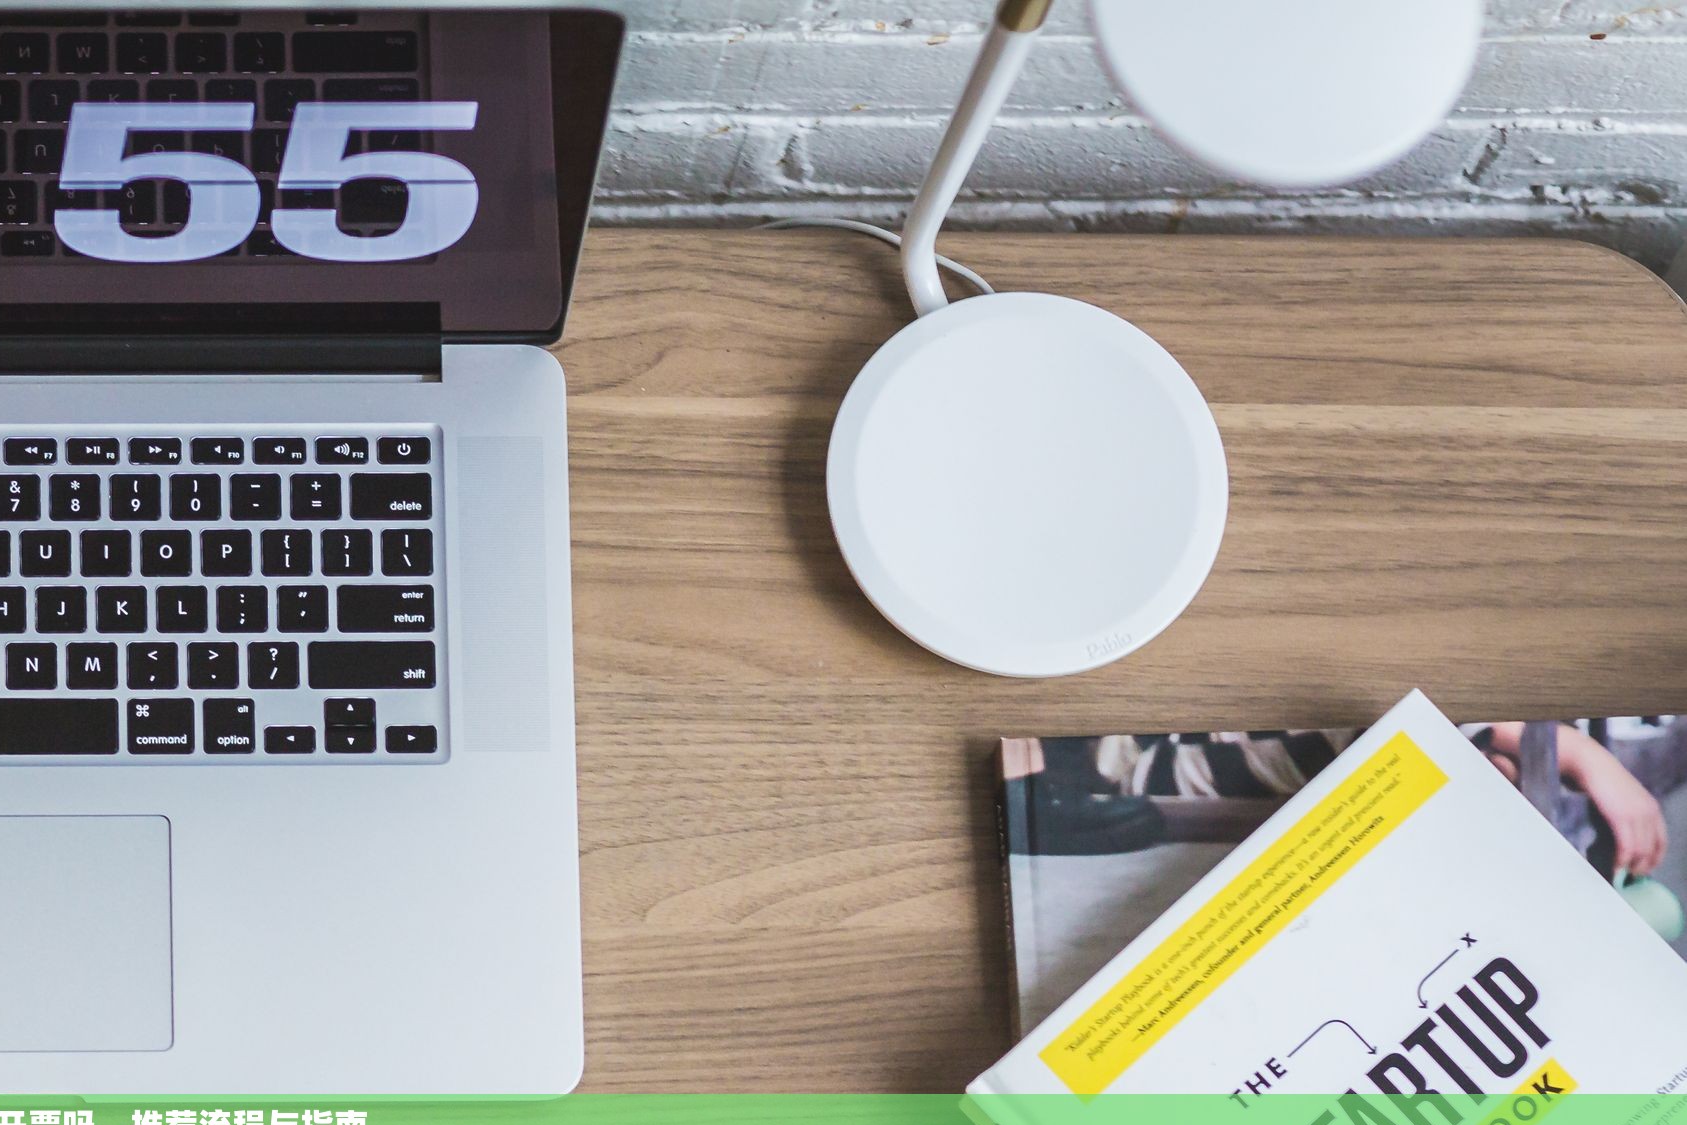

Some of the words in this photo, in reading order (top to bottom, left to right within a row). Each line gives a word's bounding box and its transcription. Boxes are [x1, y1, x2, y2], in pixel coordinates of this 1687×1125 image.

[54, 101, 479, 262] 55
[43, 452, 54, 460] F7
[105, 452, 116, 460] F8
[227, 451, 241, 459] F10
[351, 451, 365, 459] F12
[10, 498, 21, 513] 7
[70, 498, 81, 512] 8
[130, 498, 141, 512] 9
[389, 500, 423, 511] delete
[39, 544, 53, 560] U
[221, 543, 233, 559] P
[401, 591, 425, 599] enter
[56, 600, 66, 616] J
[116, 600, 129, 616] K
[177, 600, 188, 615] L
[393, 613, 425, 623] return
[25, 657, 39, 673] N
[84, 656, 101, 672] M
[402, 668, 426, 680] shift
[237, 704, 249, 714] alt
[135, 733, 188, 745] command
[216, 734, 250, 748] option
[1228, 1056, 1289, 1110] THE
